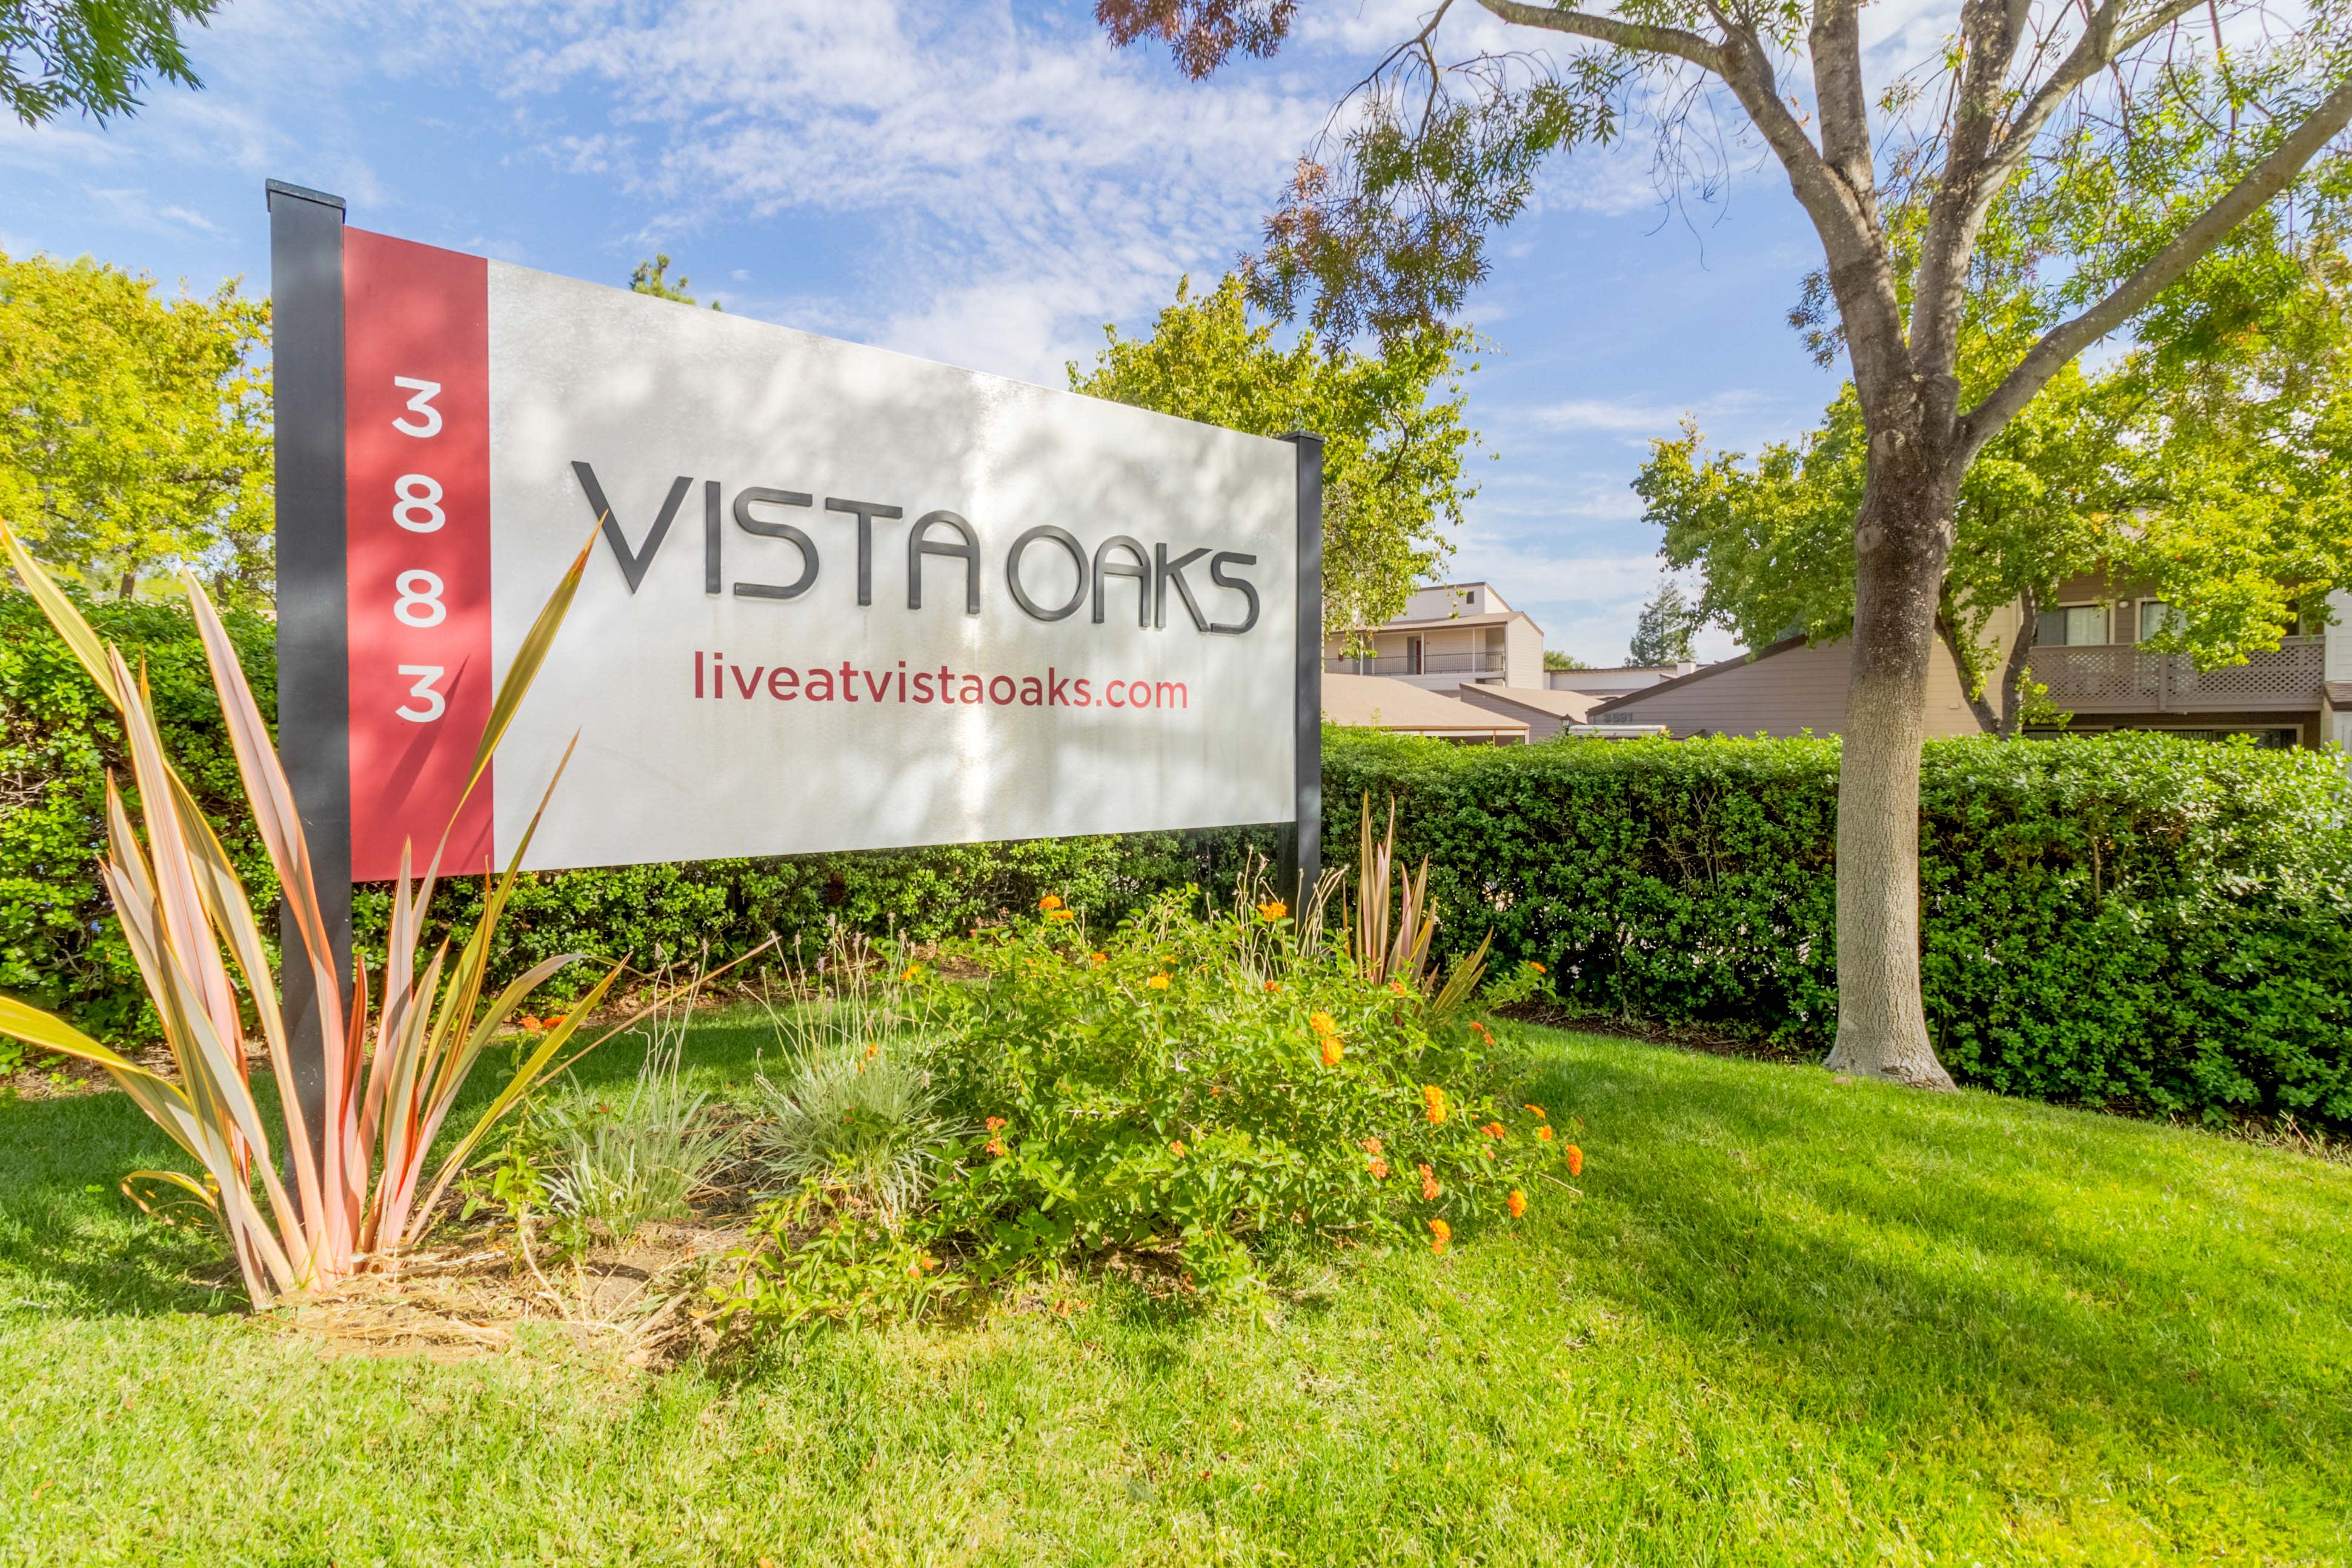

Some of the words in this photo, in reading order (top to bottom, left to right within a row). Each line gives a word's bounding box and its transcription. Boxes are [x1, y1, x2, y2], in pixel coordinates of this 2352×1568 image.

[391, 375, 447, 723] 3883
[571, 460, 981, 614] VISTA
[1006, 525, 1261, 636] OAKS
[694, 651, 1188, 709] liveatvistaoaks.com
